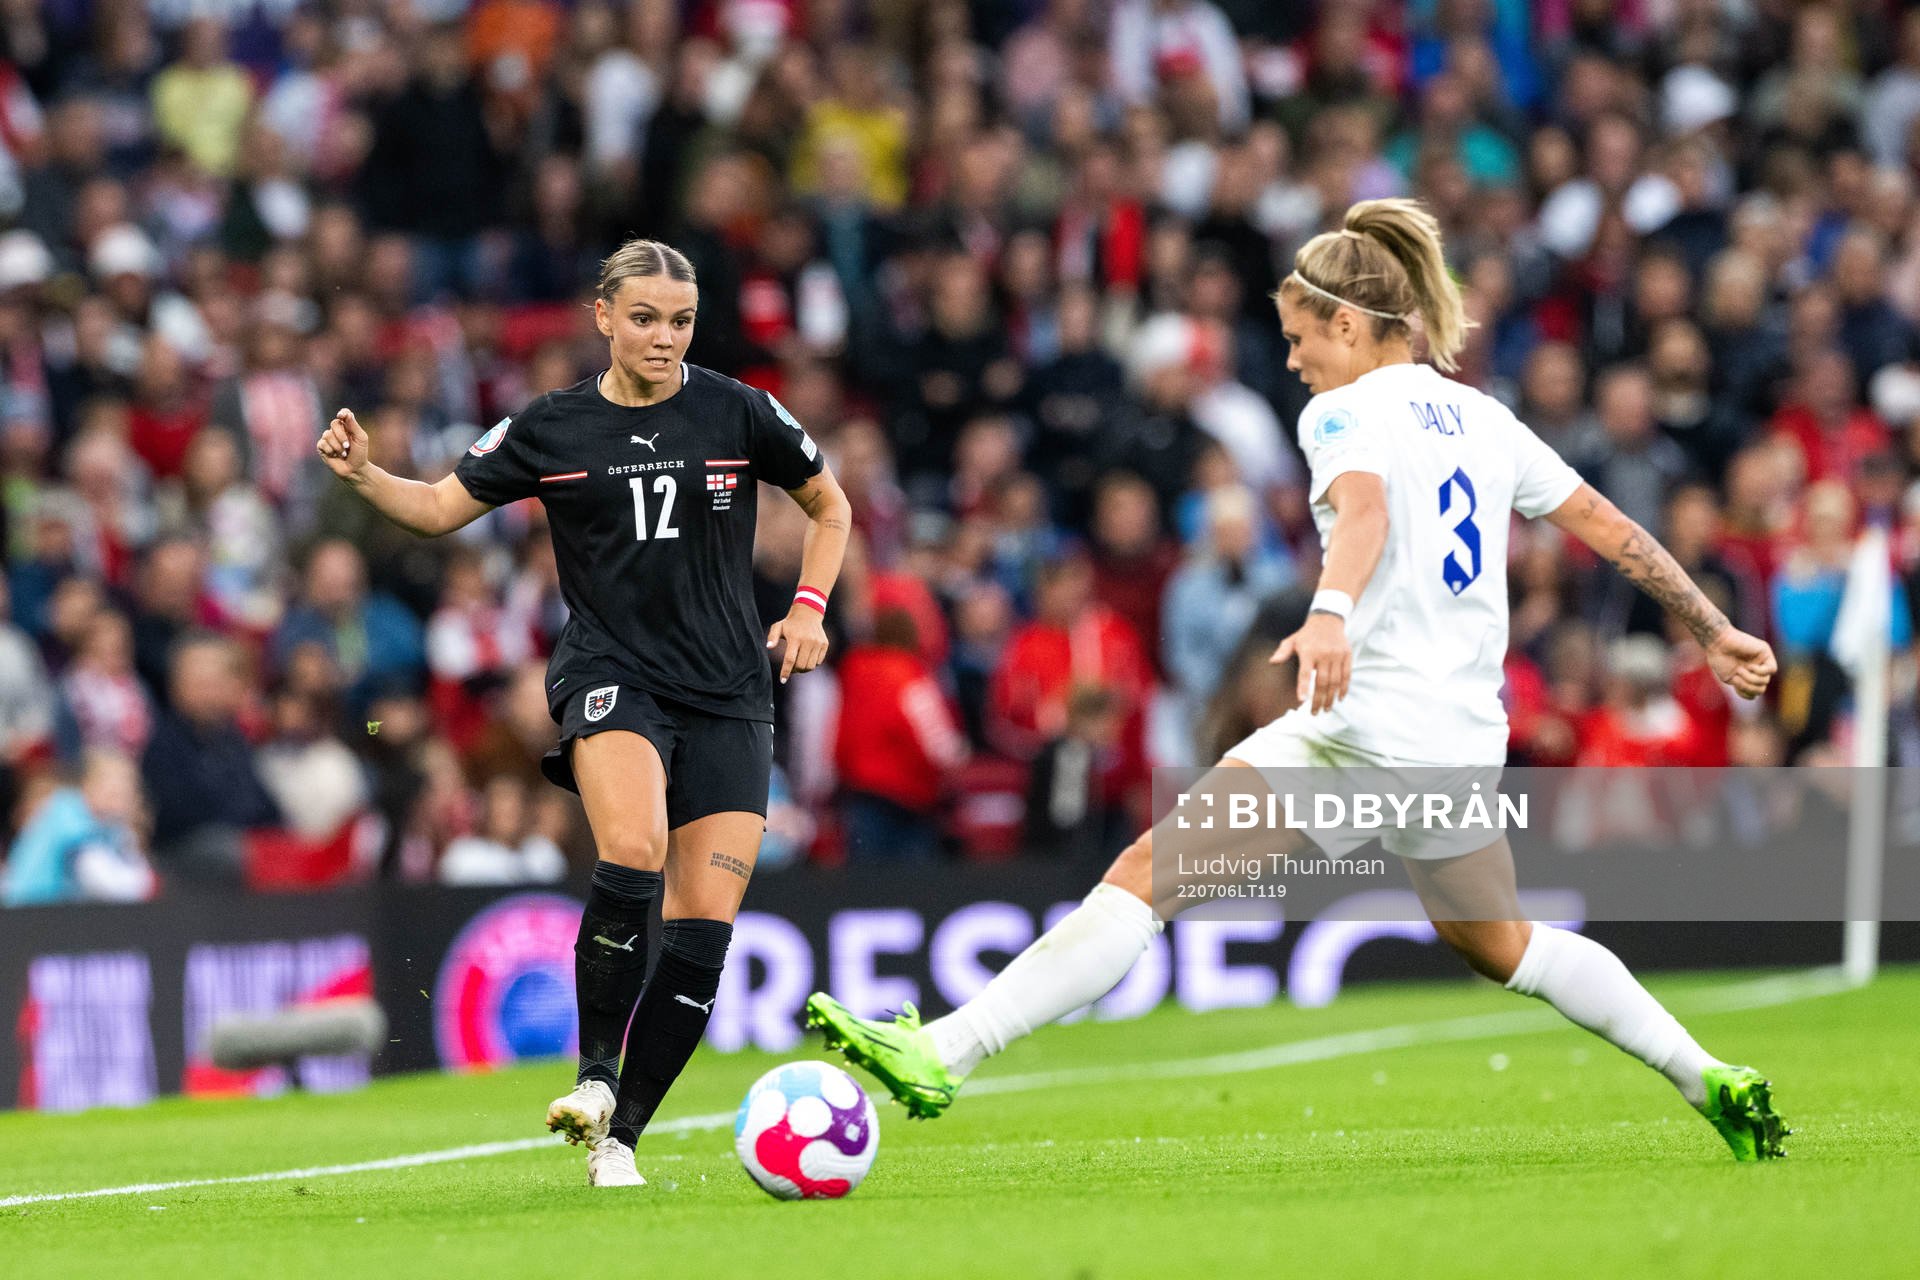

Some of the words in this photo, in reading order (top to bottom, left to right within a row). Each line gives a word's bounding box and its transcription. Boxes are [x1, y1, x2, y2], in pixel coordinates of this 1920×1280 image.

[1410, 401, 1465, 436] DALY
[608, 460, 685, 475] ÖSTERREICH
[629, 475, 679, 541] 12
[1438, 466, 1482, 597] 3
